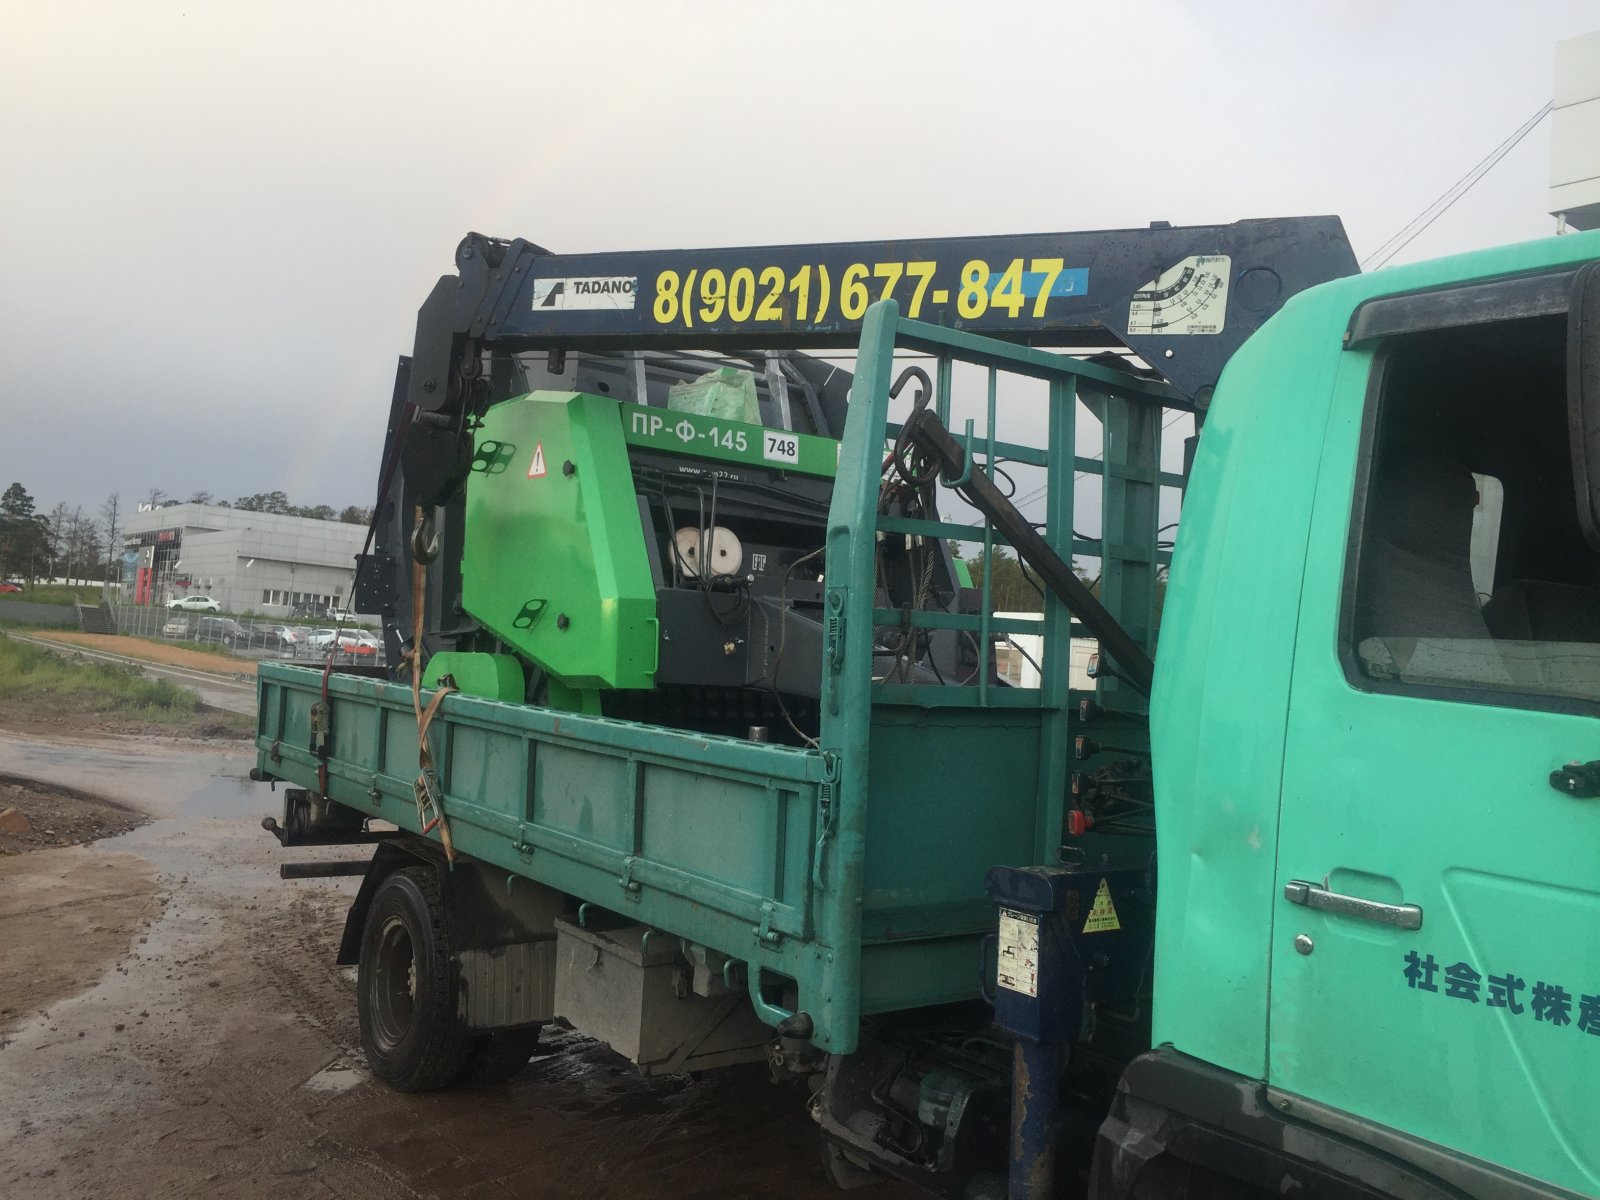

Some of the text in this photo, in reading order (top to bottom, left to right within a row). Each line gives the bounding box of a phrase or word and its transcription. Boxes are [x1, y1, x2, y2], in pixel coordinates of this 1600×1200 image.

[574, 280, 633, 294] TADANO
[632, 412, 748, 452] ПР-Ф-145
[767, 437, 795, 457] 748
